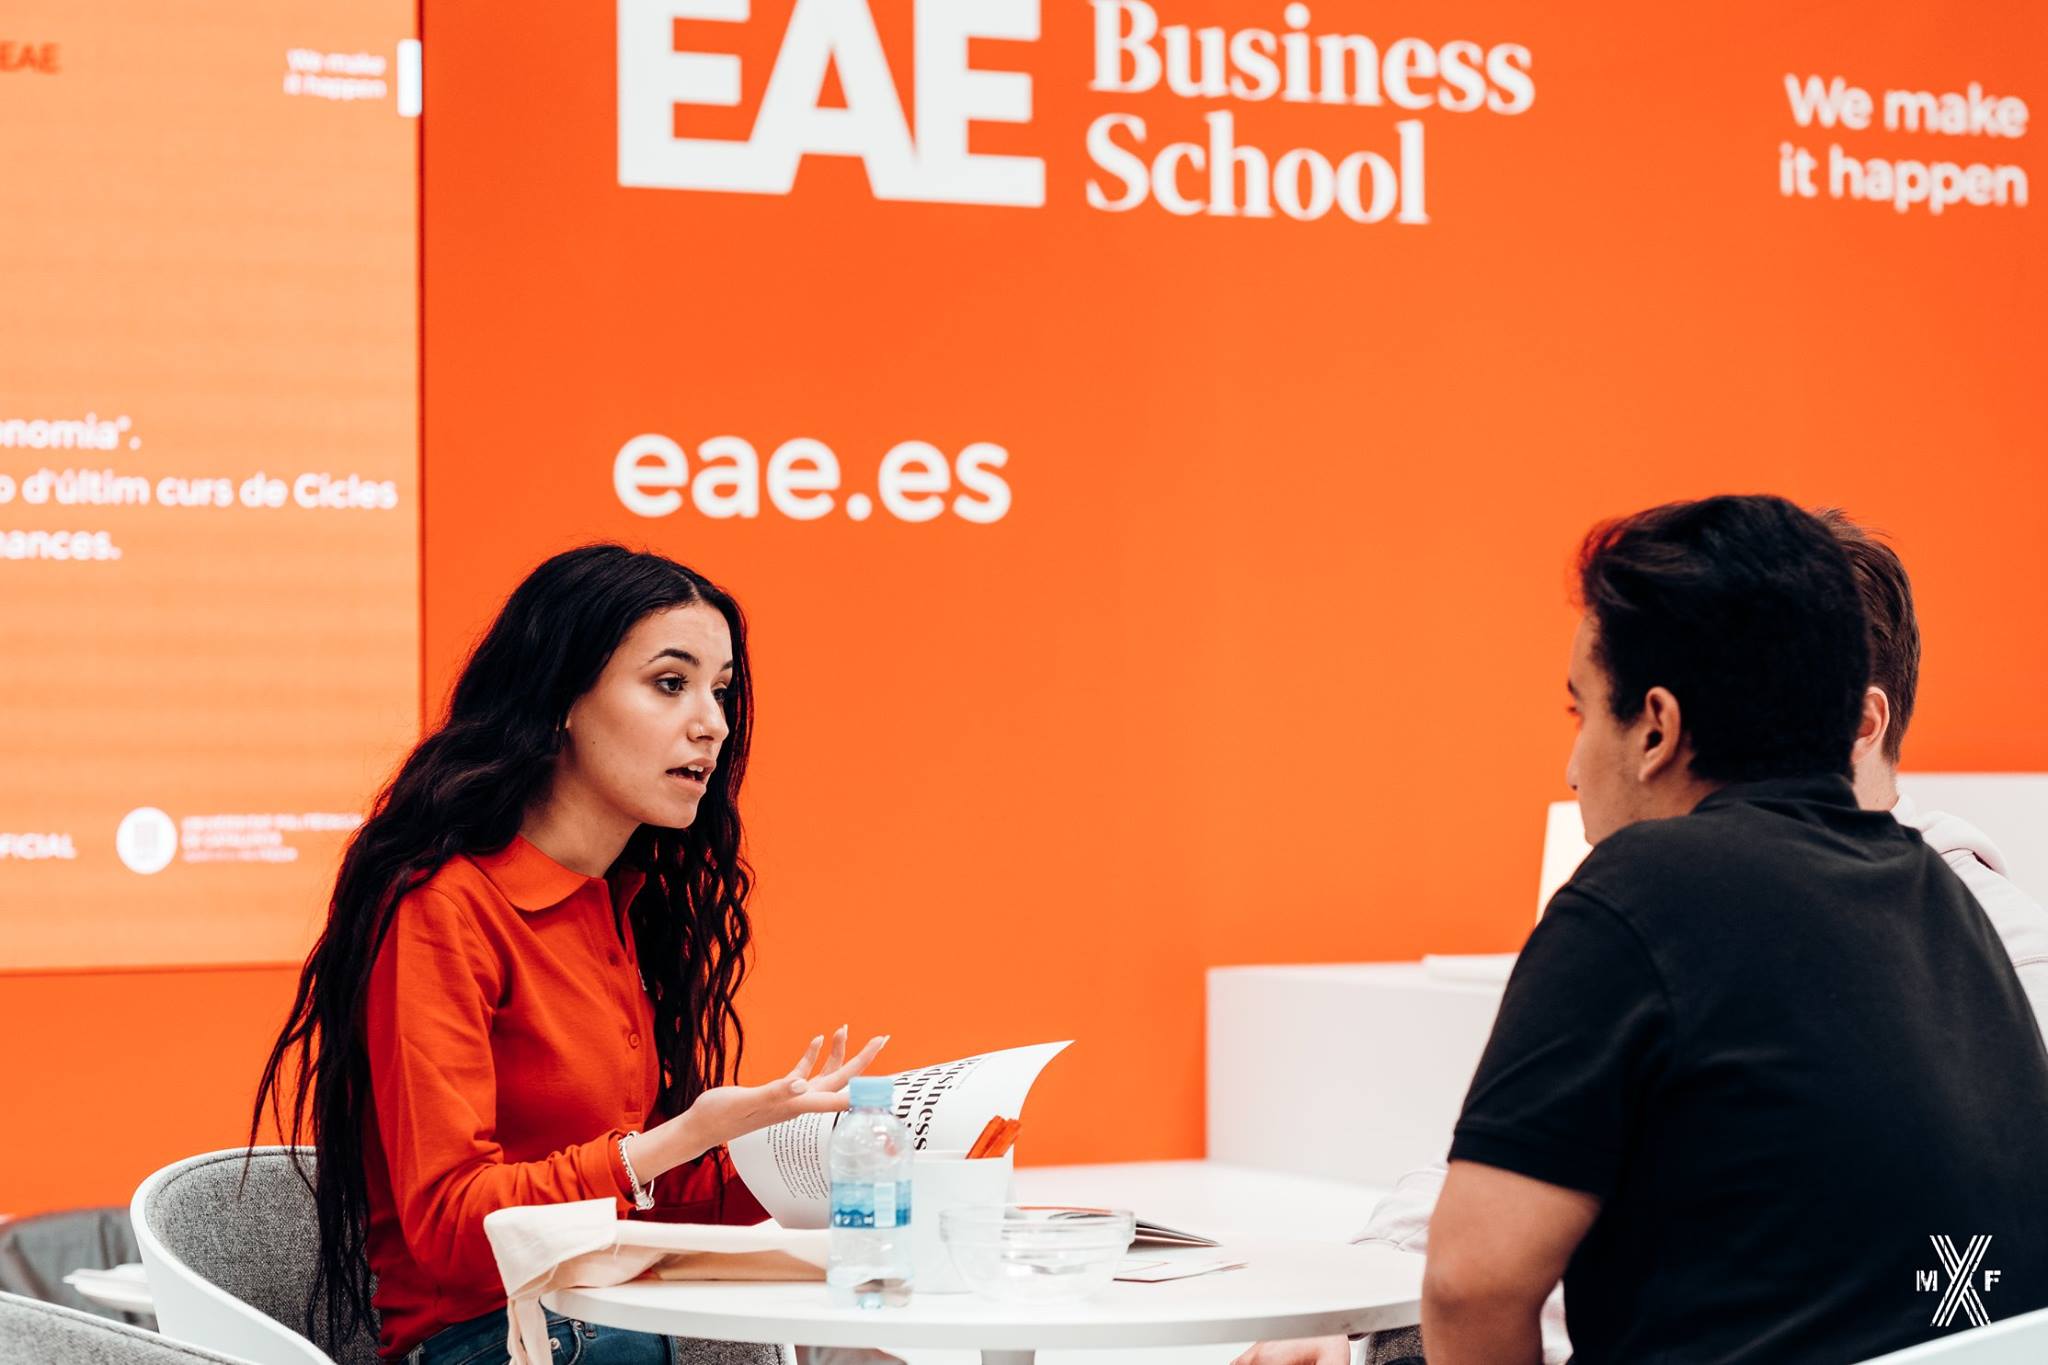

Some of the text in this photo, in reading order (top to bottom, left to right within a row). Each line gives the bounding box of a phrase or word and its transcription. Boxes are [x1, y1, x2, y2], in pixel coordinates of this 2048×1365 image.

[1088, 0, 1536, 115] Business
[616, 0, 1046, 208] EAE
[1784, 73, 2029, 138] We make
[1086, 110, 1429, 225] School
[1779, 142, 2029, 216] it happen
[156, 476, 235, 507] curs
[239, 471, 289, 508] de
[293, 473, 399, 510] Cicles
[613, 433, 1012, 524] eae.es
